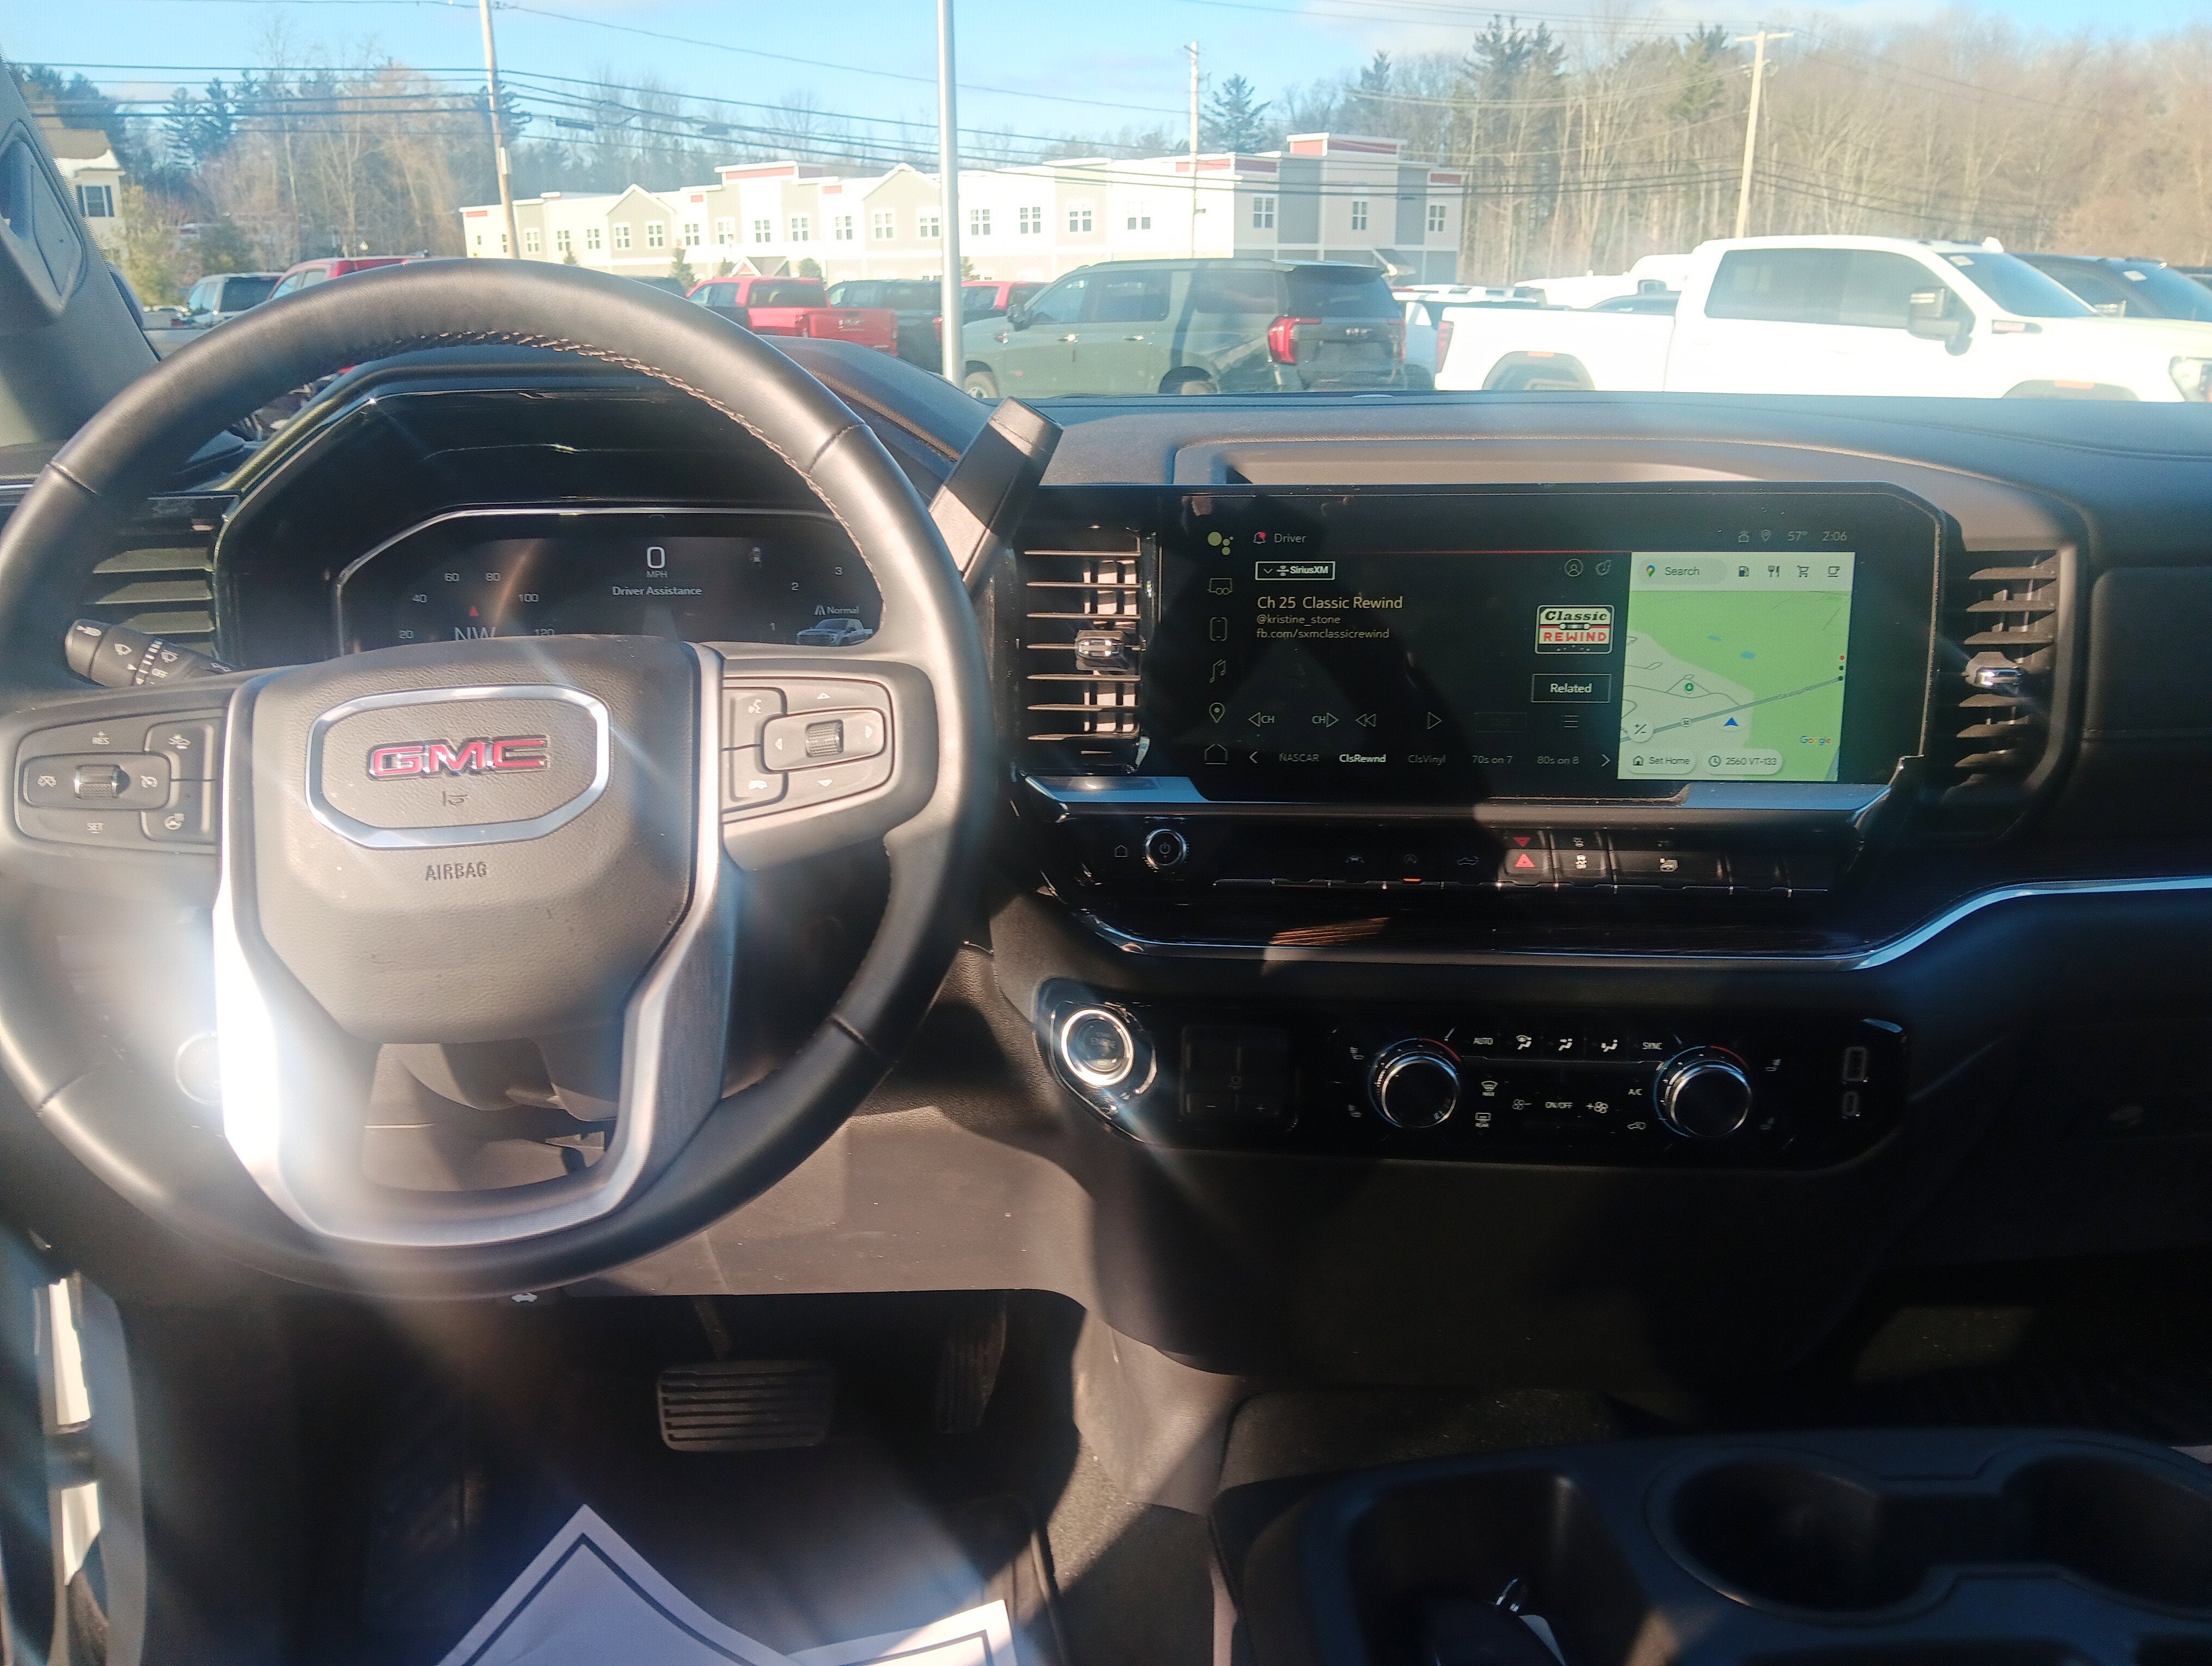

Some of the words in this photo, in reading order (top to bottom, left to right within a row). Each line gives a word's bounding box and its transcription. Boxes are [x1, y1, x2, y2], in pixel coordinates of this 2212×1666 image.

[1274, 533, 1307, 543] Driver
[1822, 531, 1847, 541] 2:06
[647, 546, 666, 569] 0
[835, 566, 843, 575] 3
[1290, 566, 1328, 574] SiriusXM
[1664, 566, 1700, 575] Search
[445, 573, 460, 581] 60
[485, 573, 500, 581] 80
[612, 586, 645, 595] Driver
[646, 586, 702, 595] Assistance
[791, 582, 799, 591] 2
[412, 594, 427, 603] 40
[518, 594, 539, 603] 100
[1257, 596, 1275, 608] Ch
[1279, 597, 1296, 608] 25
[1302, 596, 1349, 608] Classic
[1353, 596, 1403, 608] Rewind
[827, 606, 859, 614] Normal
[1256, 614, 1341, 626] @kristine_stone
[1545, 611, 1607, 621] Classic
[769, 623, 775, 631] 1
[399, 630, 414, 639] 20
[1256, 628, 1390, 638] fb.com/sxmclassicrewind
[1544, 632, 1606, 642] REWIND
[1550, 683, 1592, 693] Related
[369, 737, 549, 778] GMC
[1279, 753, 1320, 762] NASCAR
[1339, 754, 1386, 762] ClsRewnd
[1472, 755, 1489, 764] 70s
[1507, 755, 1513, 764] 7
[1667, 757, 1690, 765] Home
[426, 862, 487, 881] AIRBAG
